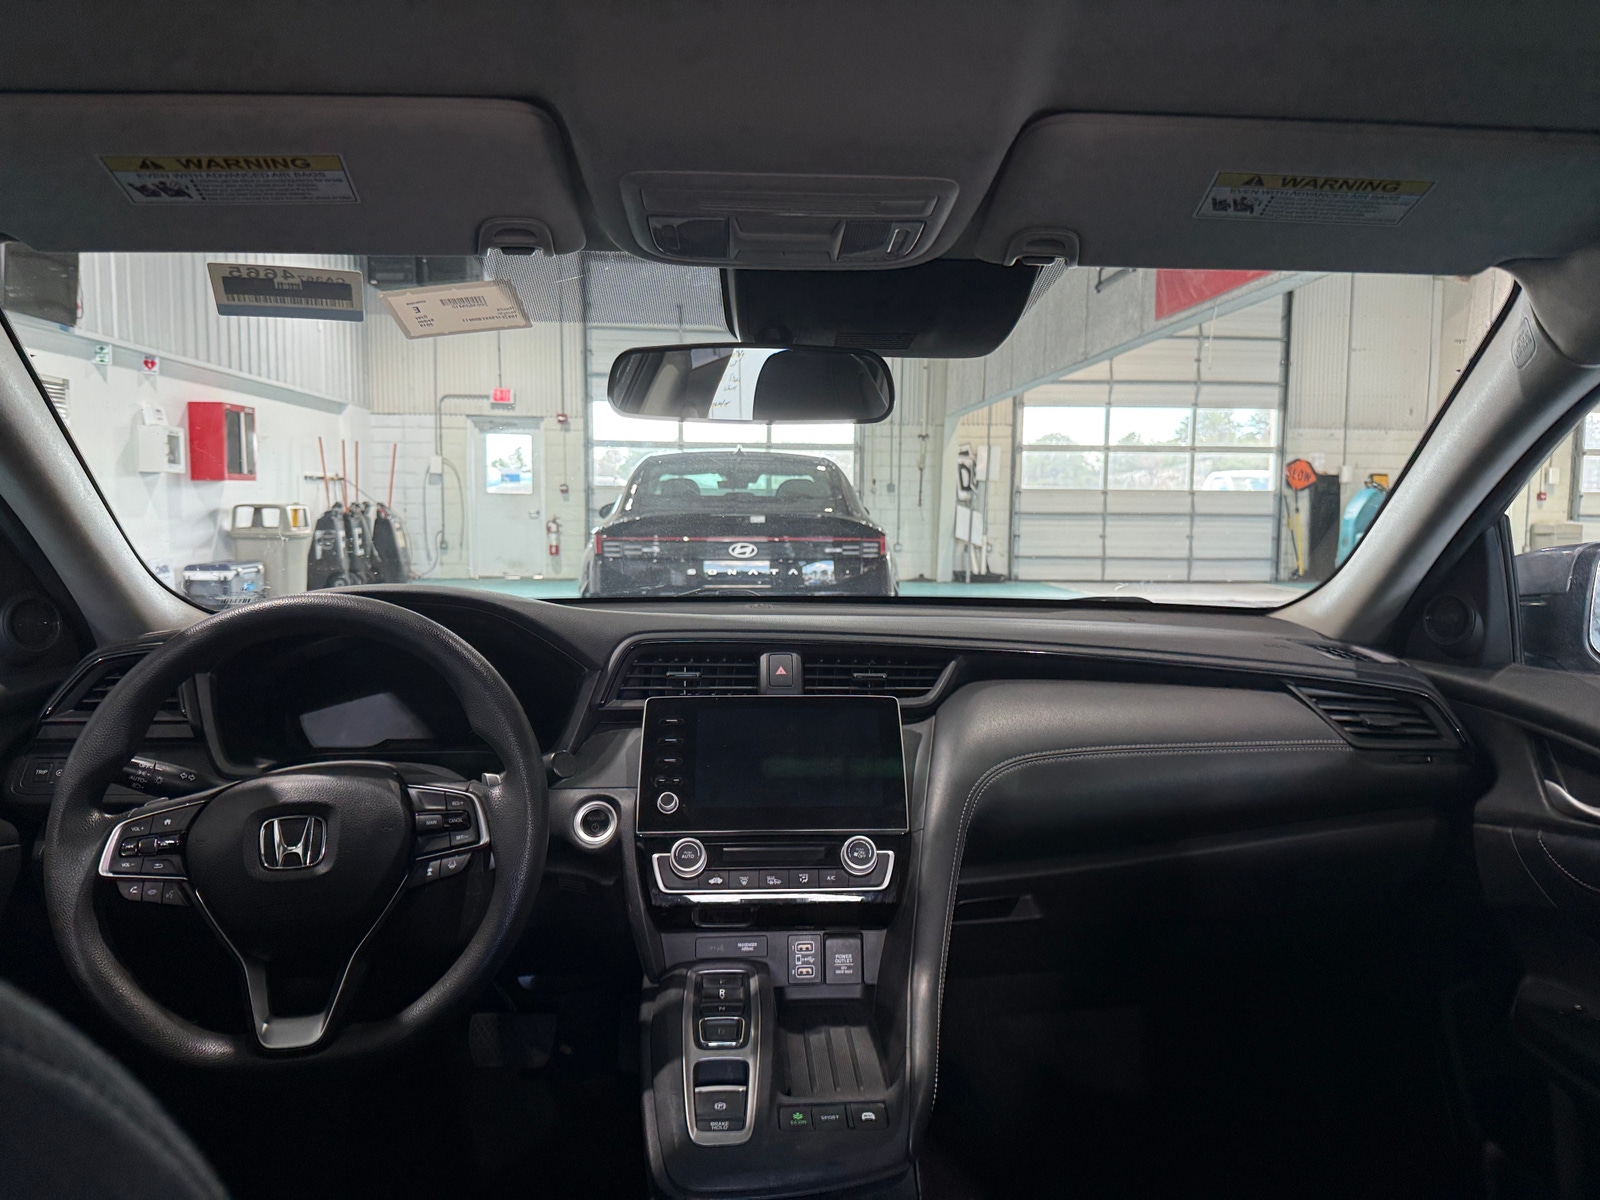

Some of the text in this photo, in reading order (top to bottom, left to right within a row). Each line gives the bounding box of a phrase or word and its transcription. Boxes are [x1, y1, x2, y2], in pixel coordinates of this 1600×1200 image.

[176, 157, 311, 170] WARNING
[1281, 176, 1402, 193] WARNING
[1287, 466, 1311, 482] SLOW
[686, 568, 799, 576] SONATA
[128, 775, 145, 784] AUTO
[820, 1114, 839, 1122] SPORT
